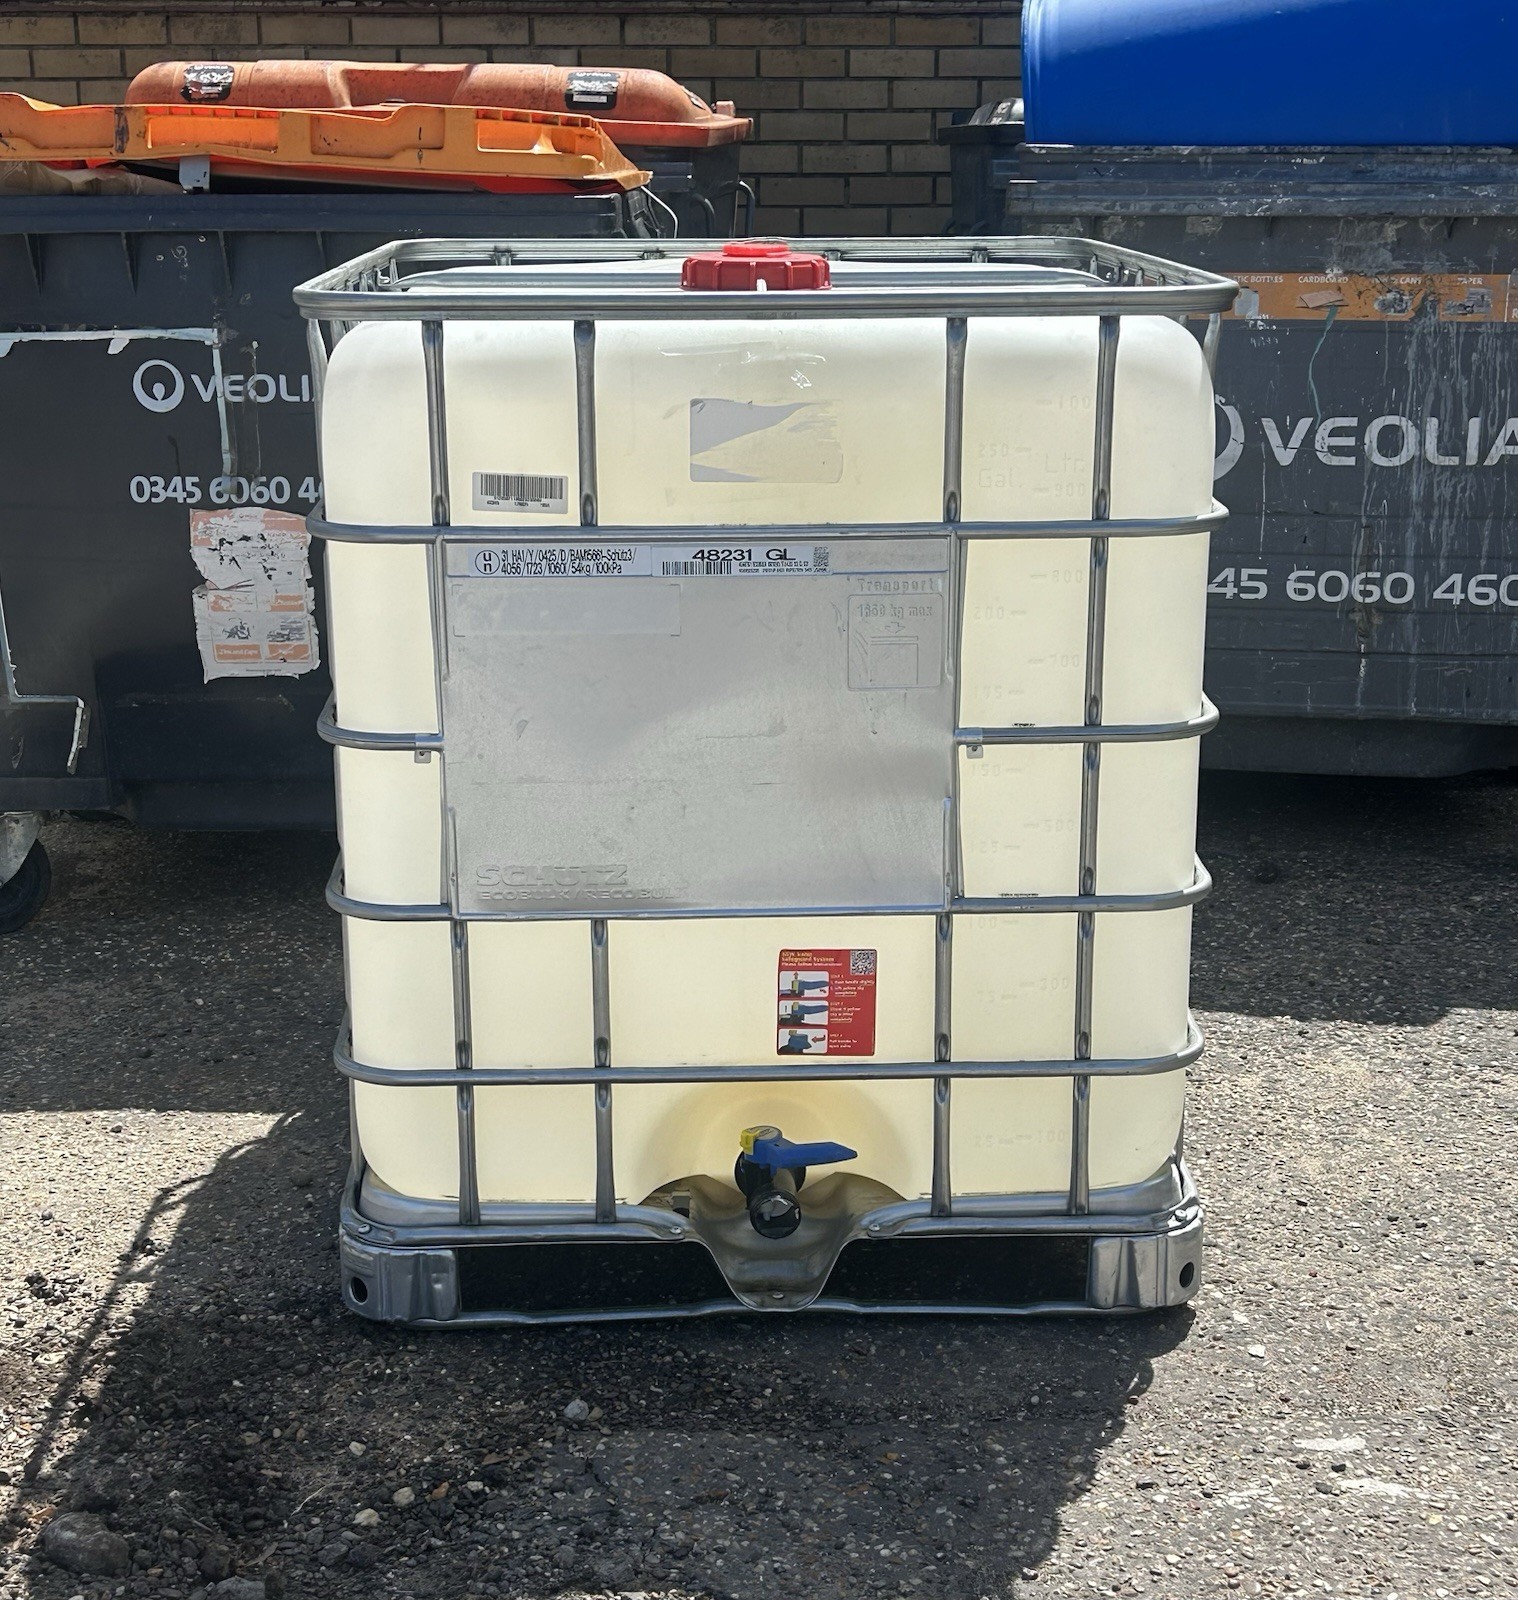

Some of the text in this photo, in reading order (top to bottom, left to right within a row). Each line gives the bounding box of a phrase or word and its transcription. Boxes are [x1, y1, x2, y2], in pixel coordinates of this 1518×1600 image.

[191, 373, 317, 404] VEOLI
[1261, 414, 1518, 467] VEOLIA
[129, 474, 322, 505] 0345 6060 4
[691, 548, 797, 562] 48231 GL
[1286, 569, 1416, 605] 6060
